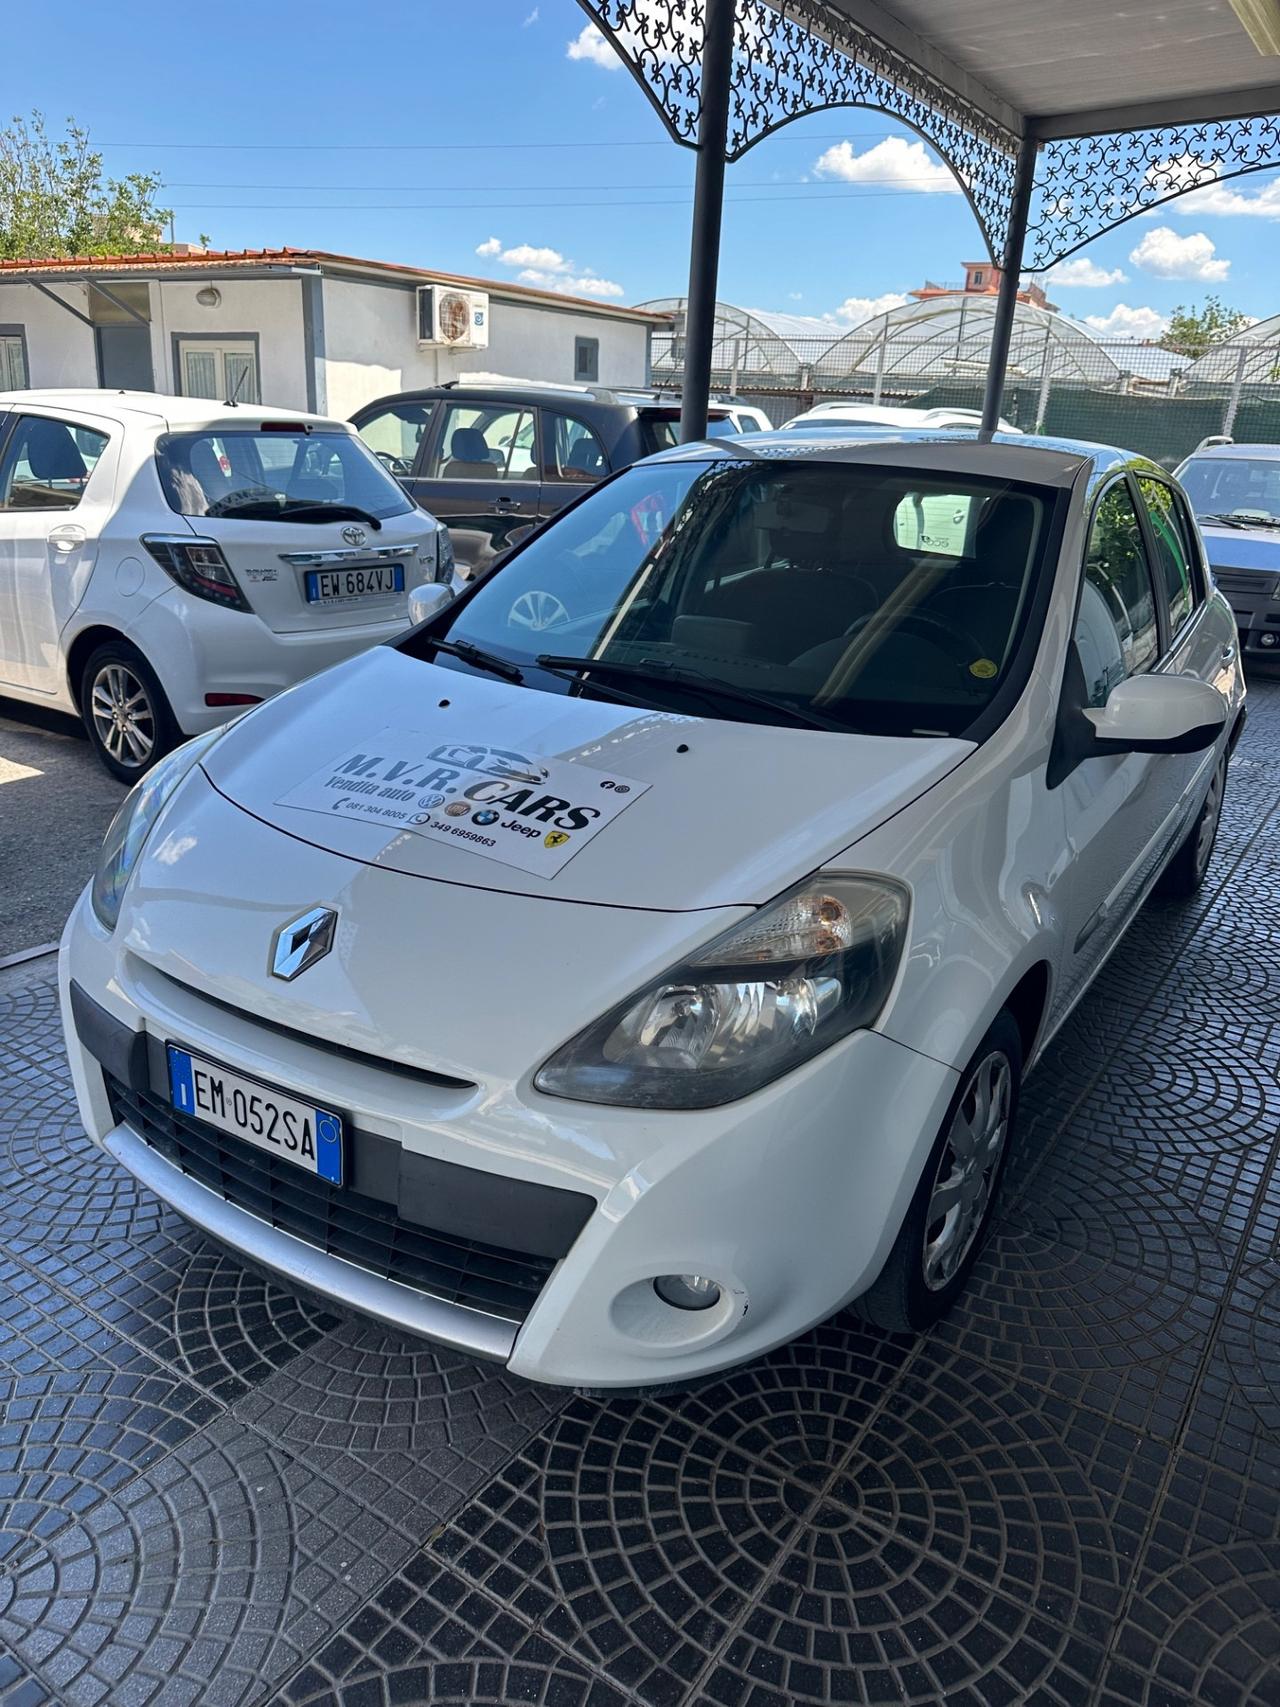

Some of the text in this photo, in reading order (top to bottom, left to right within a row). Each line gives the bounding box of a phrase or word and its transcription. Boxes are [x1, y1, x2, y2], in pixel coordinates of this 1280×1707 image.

[323, 776, 417, 802] Vendita auto
[334, 754, 601, 831] M.V.R. CARS
[345, 800, 364, 810] 081
[429, 821, 497, 848] 349 6959863
[500, 819, 542, 839] Jeep
